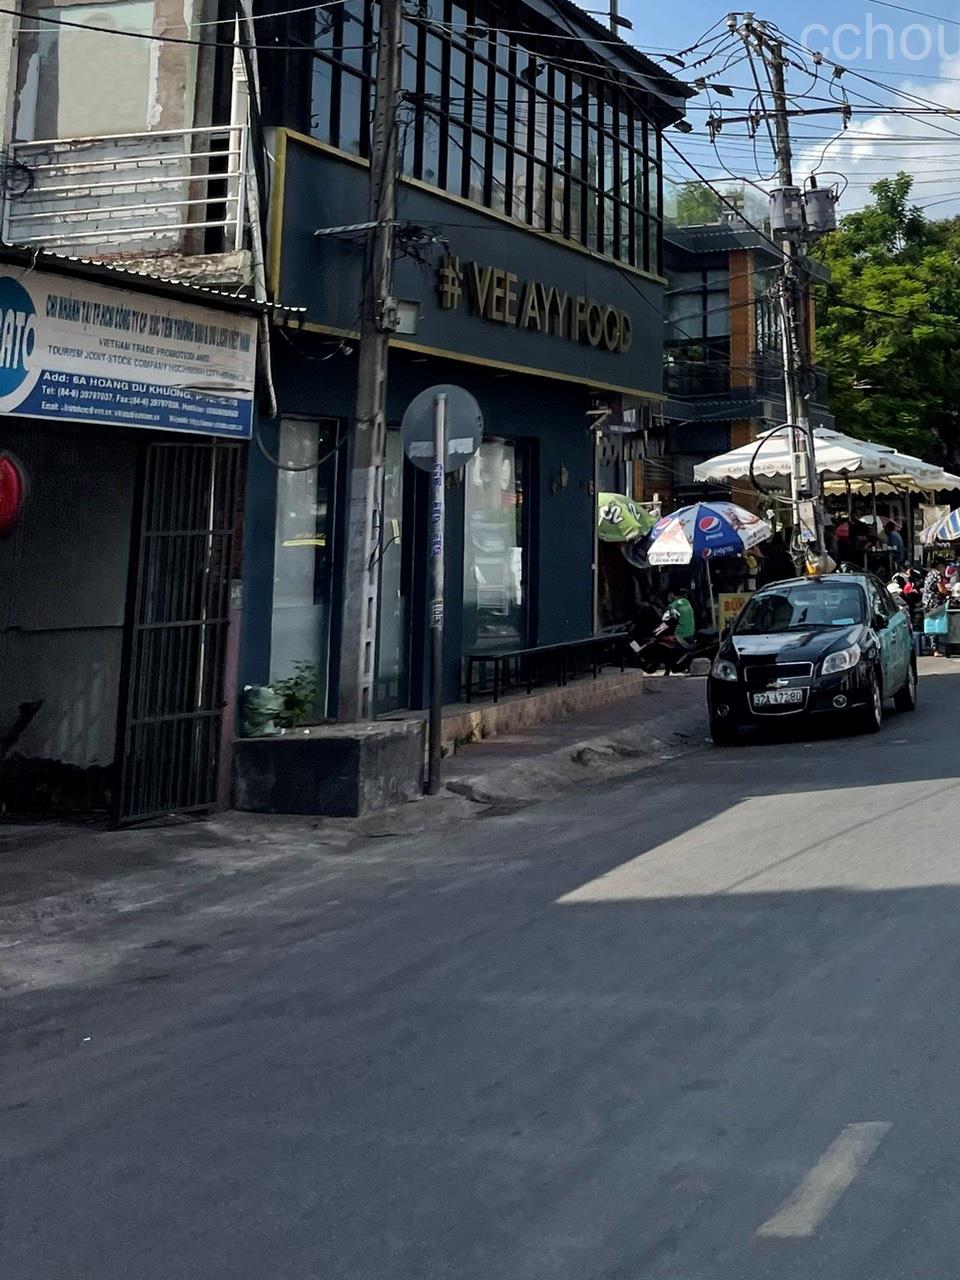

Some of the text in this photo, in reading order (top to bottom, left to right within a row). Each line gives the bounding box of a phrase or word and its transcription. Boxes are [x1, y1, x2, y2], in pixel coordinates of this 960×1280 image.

[470, 261, 518, 324] VEE
[522, 280, 568, 337] AYY
[572, 295, 632, 352] FOOD
[0, 308, 37, 371] ATO
[43, 372, 69, 383] Add:
[73, 376, 87, 385] 6A
[713, 546, 735, 557] pepsi
